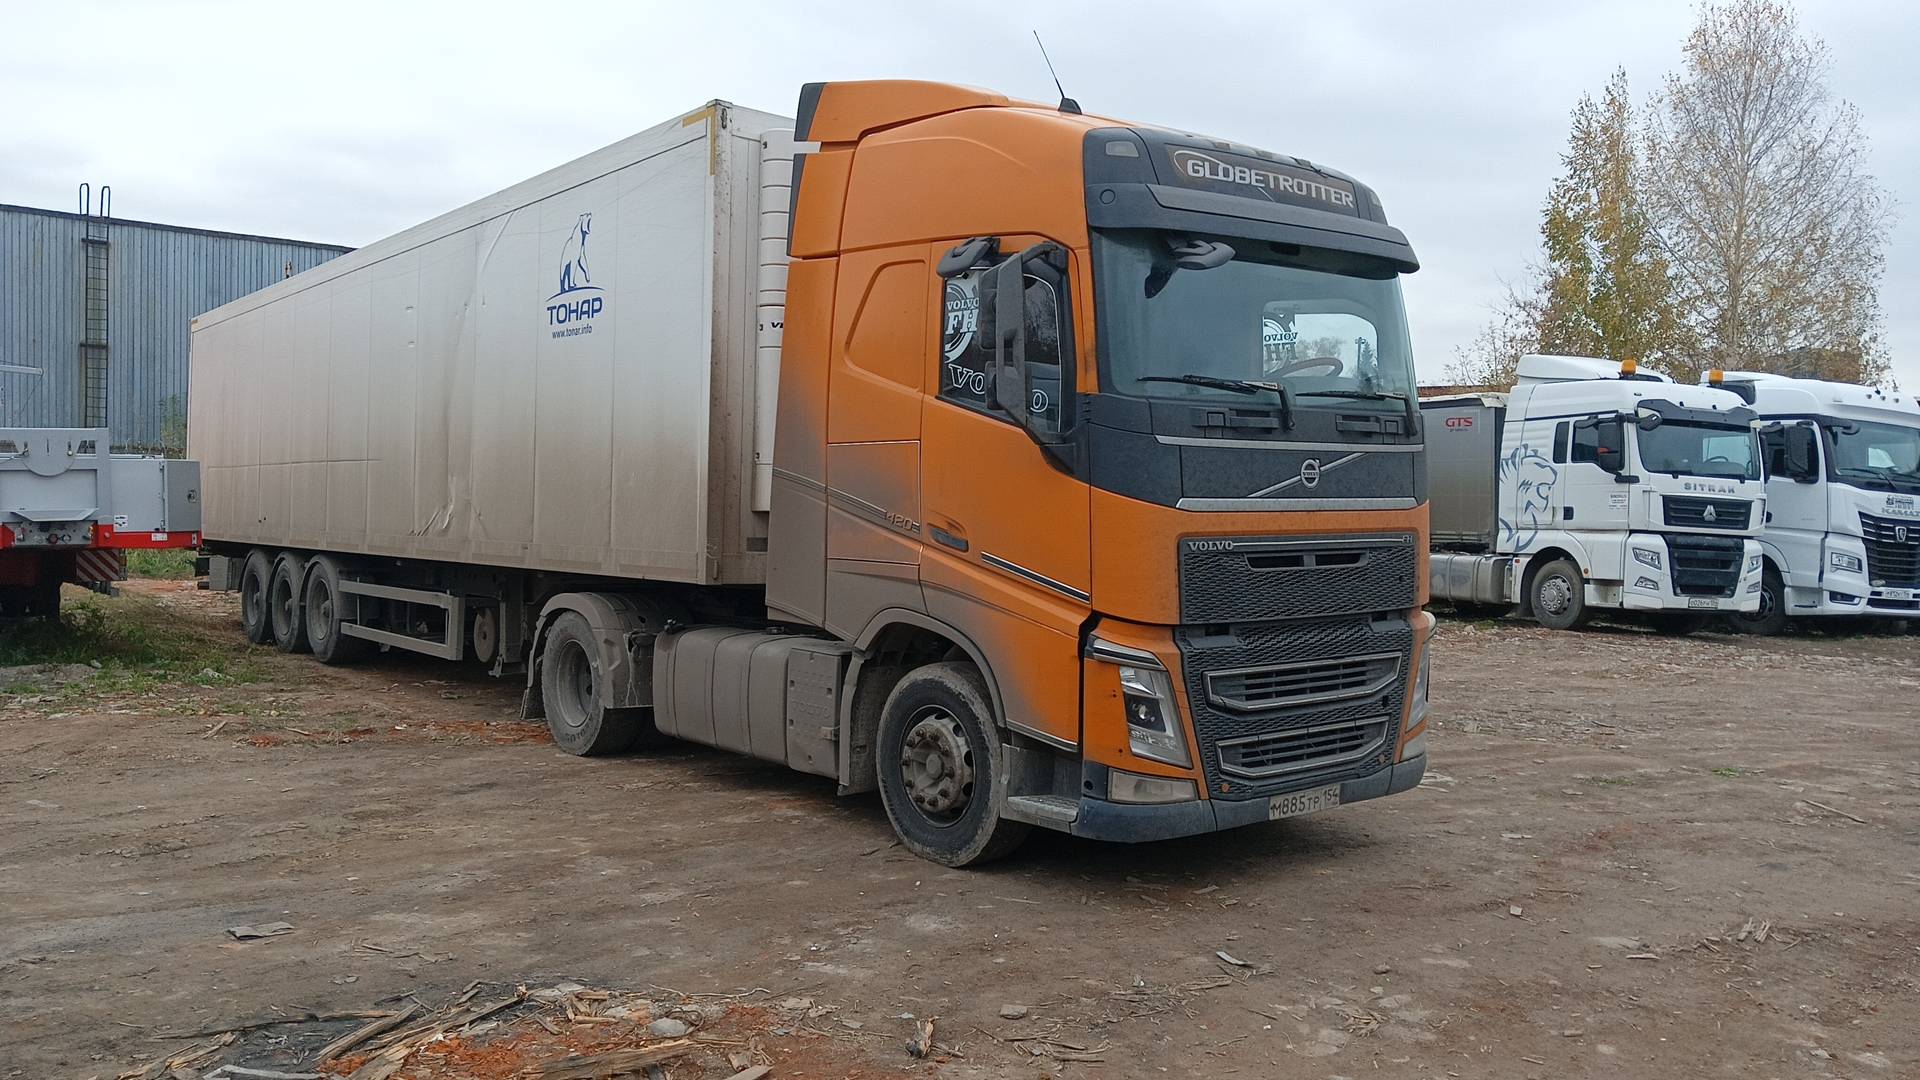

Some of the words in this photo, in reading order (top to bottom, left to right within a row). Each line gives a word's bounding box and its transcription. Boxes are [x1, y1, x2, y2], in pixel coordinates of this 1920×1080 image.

[1187, 159, 1354, 208] GLOBETROTTER
[546, 297, 603, 325] ТОНАР
[946, 297, 980, 311] VOLVO
[945, 309, 979, 335] FH
[552, 323, 592, 339] www.tonar.info
[1445, 416, 1473, 427] GTS
[1683, 482, 1736, 494] SITRAK
[886, 512, 912, 531] 420
[1187, 540, 1234, 551] VOLVO
[1322, 788, 1338, 803] 154
